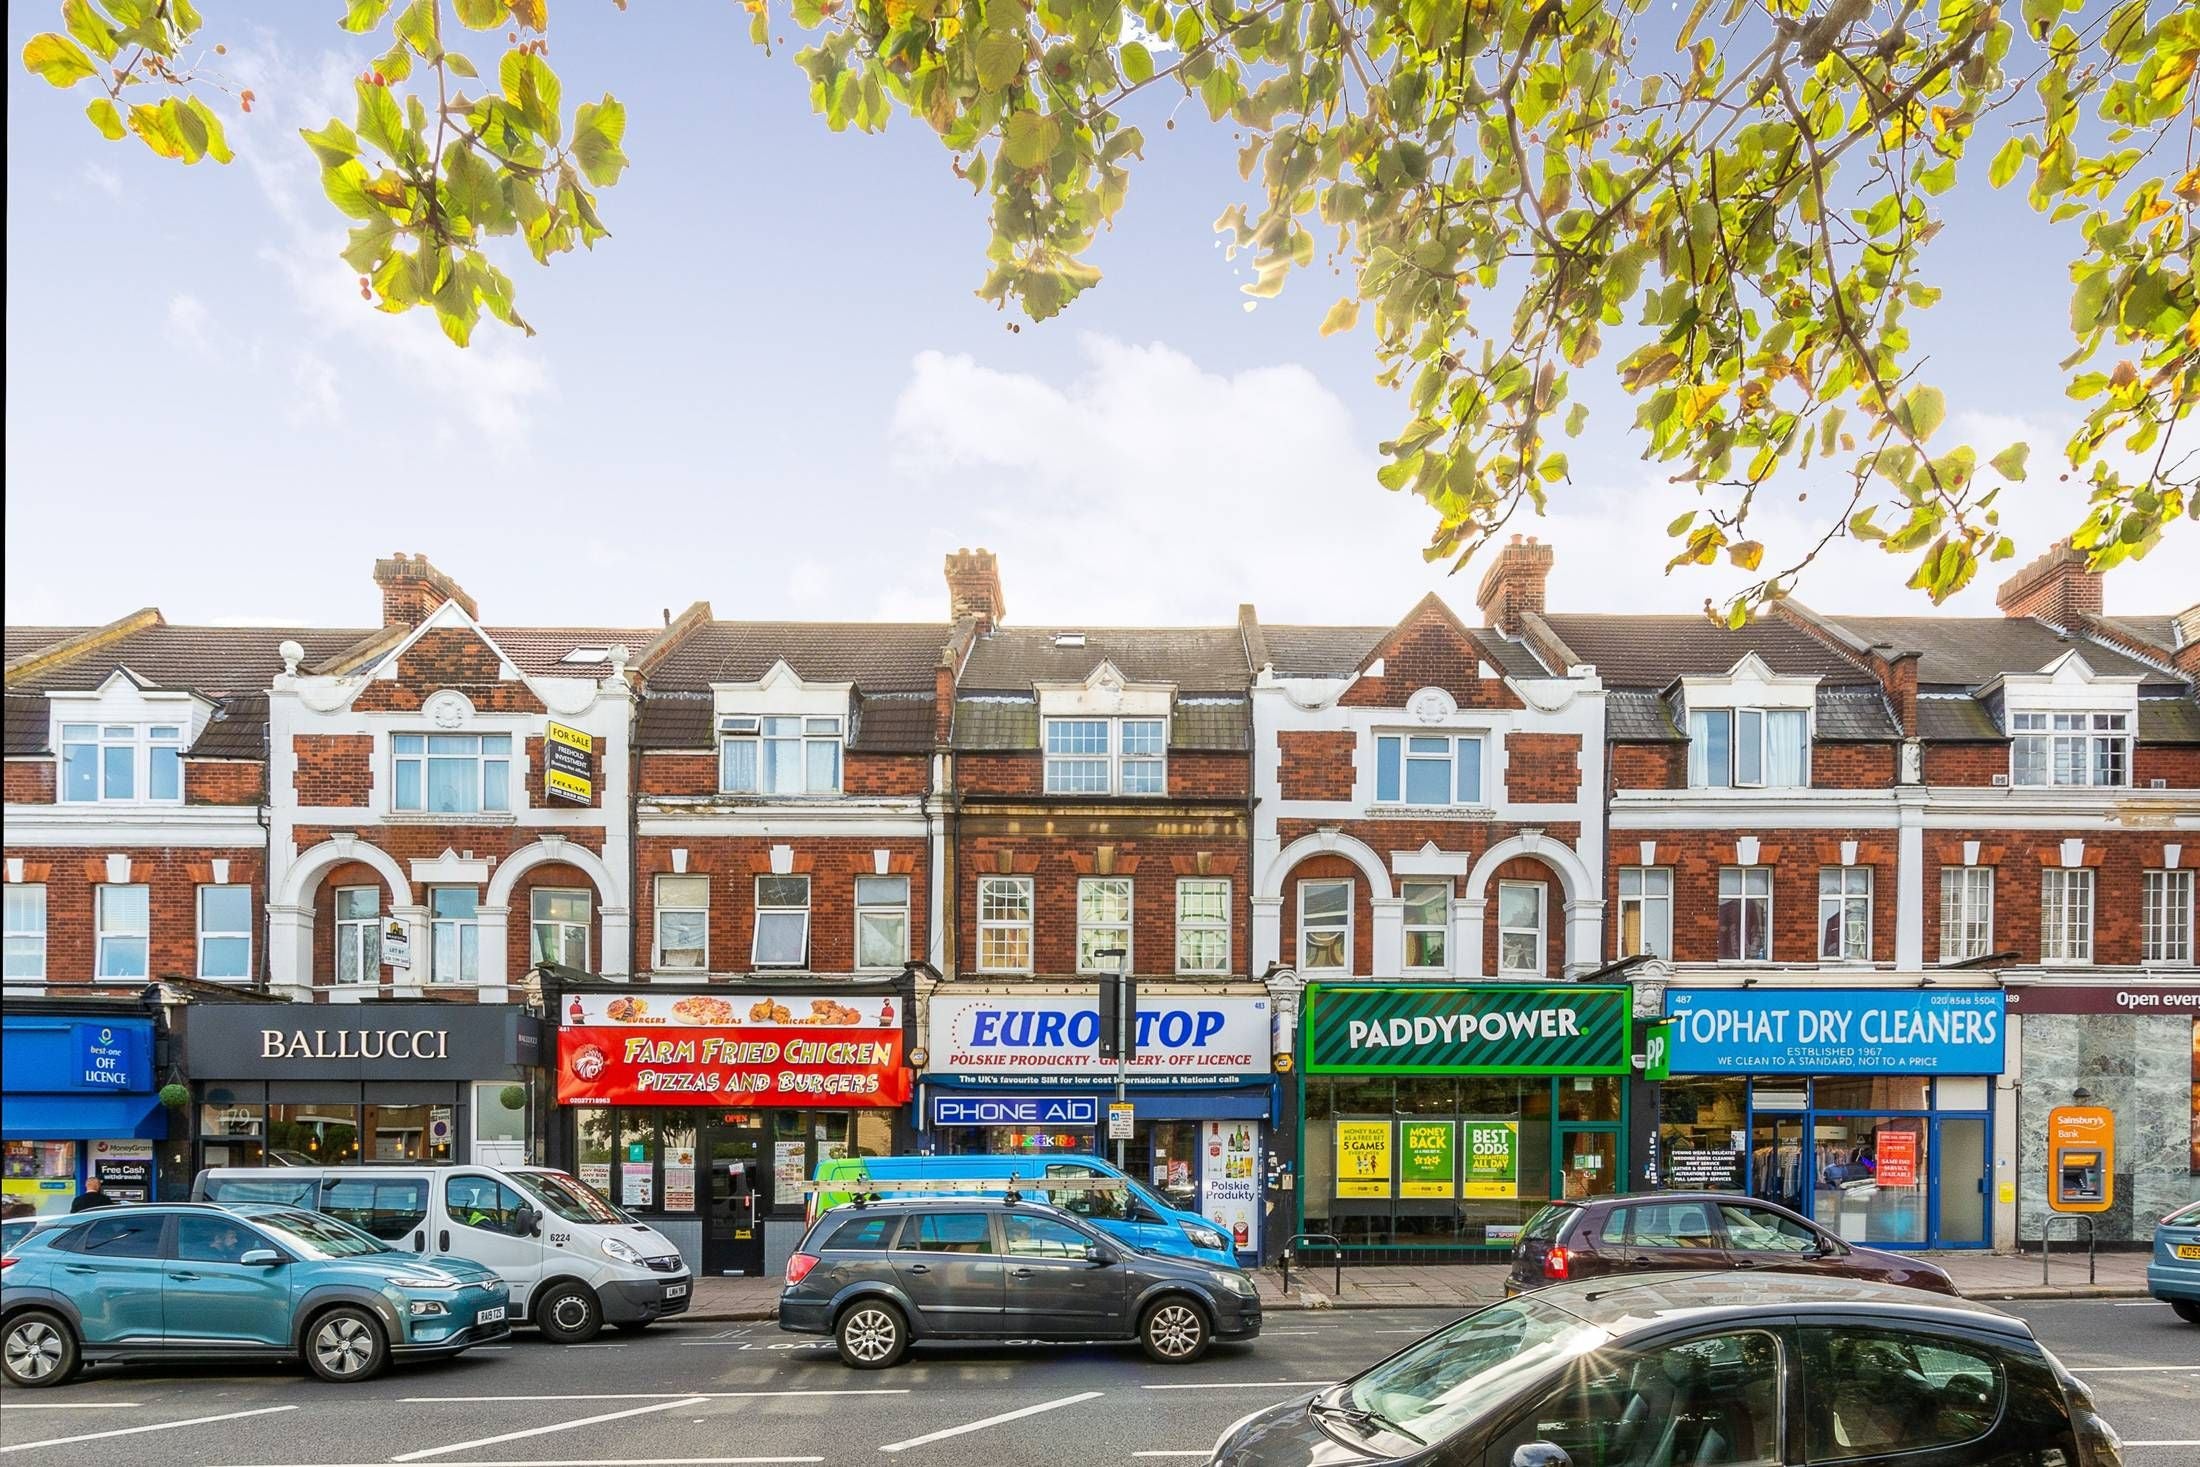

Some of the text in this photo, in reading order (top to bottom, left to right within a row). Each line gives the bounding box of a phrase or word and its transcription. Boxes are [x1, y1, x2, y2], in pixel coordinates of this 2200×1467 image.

[553, 727, 590, 747] FOR SALE
[558, 745, 585, 760] FREEHOLD
[554, 752, 588, 769] INVESTMENT
[1675, 995, 1996, 1005] 487 020 8568 5504
[2116, 990, 2200, 1009] Open ever
[1254, 1002, 1266, 1010] 483
[626, 1016, 667, 1025] BURGERS
[709, 1017, 743, 1025] PIZZAS
[1674, 1009, 1998, 1045] TOPHAT DRY CLEANERS
[260, 1029, 450, 1059] BALLUCCI
[90, 1045, 122, 1057] best-one
[623, 1037, 893, 1067] FARM FRIED CHICKEN
[1787, 1047, 1883, 1057] ESTBLISHED 1967
[96, 1057, 116, 1069] OFF
[949, 1055, 1006, 1066] POLSKIE
[1009, 1055, 1091, 1066] PRODUCKTY
[1169, 1055, 1198, 1065] OFF
[1197, 1055, 1252, 1065] LICENCE
[1717, 1056, 1938, 1067] WE CLEAN TO A STANDARD, NOT TO A PRICE
[85, 1070, 127, 1085] LICENCE
[636, 1069, 880, 1095] PIZZAS AND BURGERS
[959, 1075, 976, 1084] The
[977, 1075, 999, 1084] UK's
[1000, 1075, 1039, 1084] favourite
[1041, 1075, 1058, 1084] SIM
[1060, 1075, 1073, 1084] for
[1074, 1075, 1089, 1084] low
[1092, 1075, 1113, 1084] cost
[1171, 1075, 1178, 1084] &
[1180, 1075, 1217, 1084] National
[1218, 1075, 1240, 1084] calls
[939, 1103, 1038, 1121] PHONE
[724, 1114, 749, 1124] OPEN
[2057, 1115, 2104, 1126] Sainsbury's
[1410, 1127, 1446, 1137] MONEY
[1472, 1129, 1509, 1144] BEST
[2058, 1129, 2080, 1138] Bank
[1344, 1142, 1385, 1151] 5 GAMES
[1409, 1136, 1447, 1149] BACK
[110, 1144, 152, 1154] MoneyGram
[1472, 1143, 1509, 1155] ODDS
[1473, 1159, 1509, 1168] ALL DAY
[102, 1166, 145, 1174] Free Cash
[1211, 1181, 1250, 1191] Polskie
[1206, 1190, 1255, 1202] Produkty
[550, 1233, 571, 1242] 6224
[481, 1310, 493, 1322] RA19
[738, 1343, 839, 1351] LOAD
